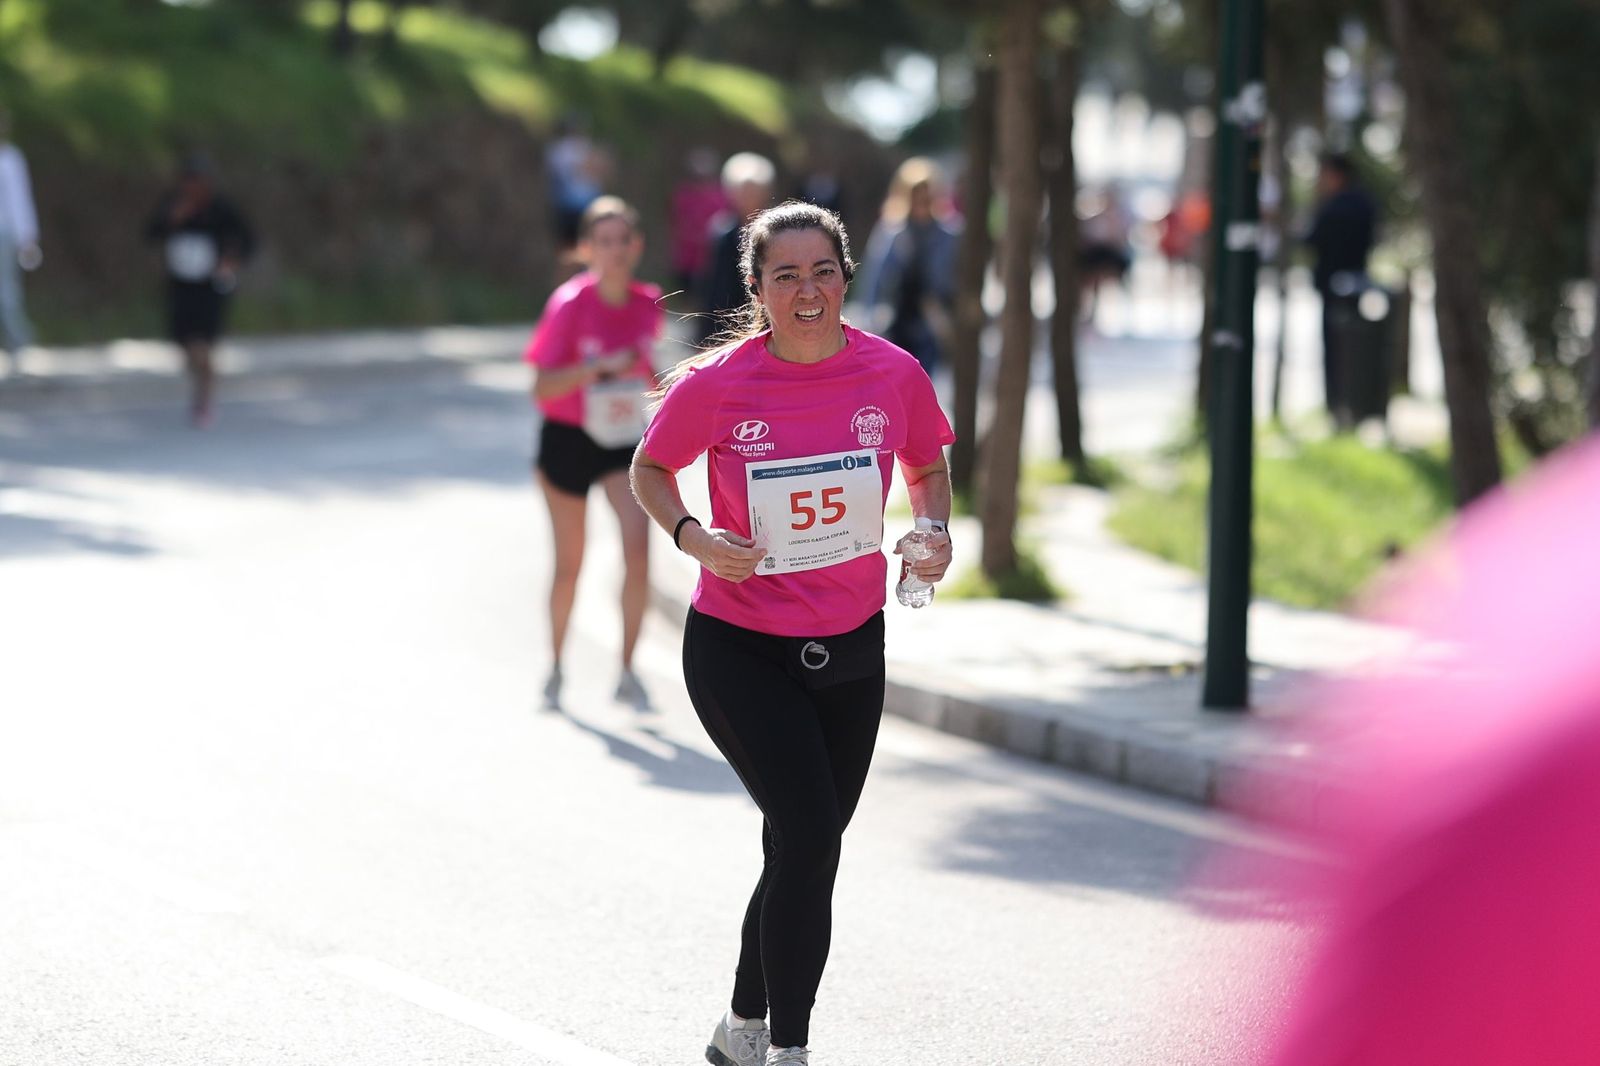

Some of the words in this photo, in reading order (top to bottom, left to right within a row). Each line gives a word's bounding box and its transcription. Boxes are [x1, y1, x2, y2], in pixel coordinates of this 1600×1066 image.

[730, 442, 775, 452] HYUNDAI
[762, 465, 823, 477] www.deporte.malaga.eu
[789, 486, 847, 531] 55
[788, 538, 811, 546] LOURDES
[830, 530, 850, 538] ESPAÑA
